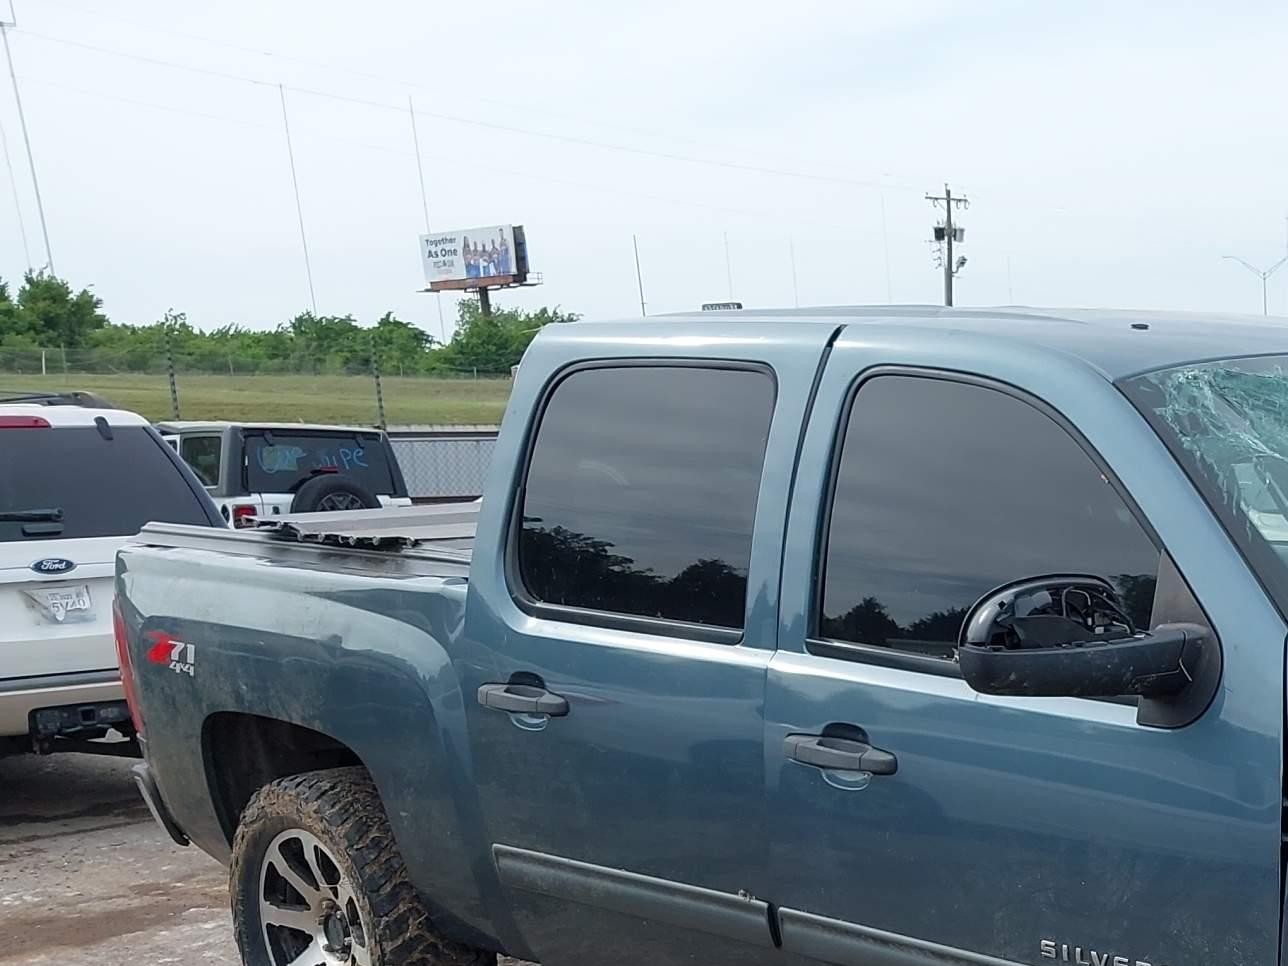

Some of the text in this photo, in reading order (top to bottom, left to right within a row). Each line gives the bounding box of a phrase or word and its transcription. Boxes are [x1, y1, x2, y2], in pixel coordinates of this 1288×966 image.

[425, 236, 456, 247] Together
[427, 247, 458, 259] As One
[40, 559, 66, 570] Ford
